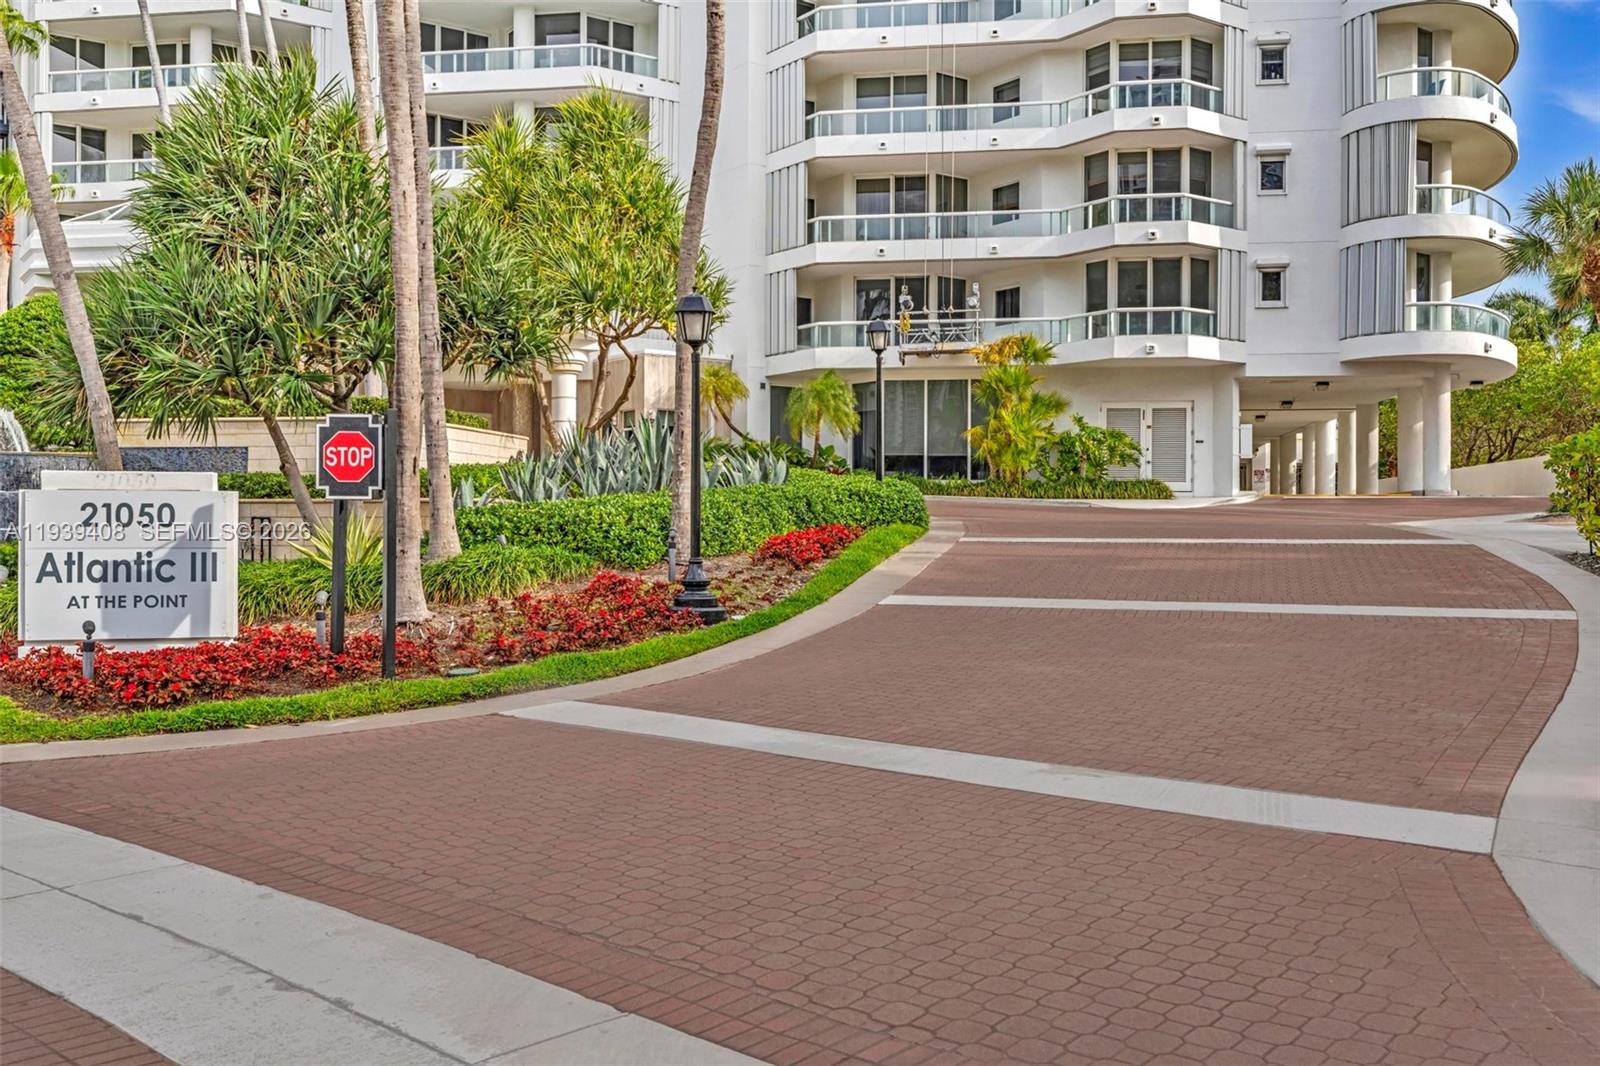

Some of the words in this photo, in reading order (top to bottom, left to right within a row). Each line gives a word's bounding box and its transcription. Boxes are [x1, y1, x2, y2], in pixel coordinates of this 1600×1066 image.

[325, 446, 372, 467] STOP
[80, 502, 176, 528] 21050
[35, 551, 176, 583] Atlantic
[190, 552, 218, 582] III
[66, 595, 90, 609] AT
[94, 595, 127, 609] THE
[133, 594, 188, 608] POINT
